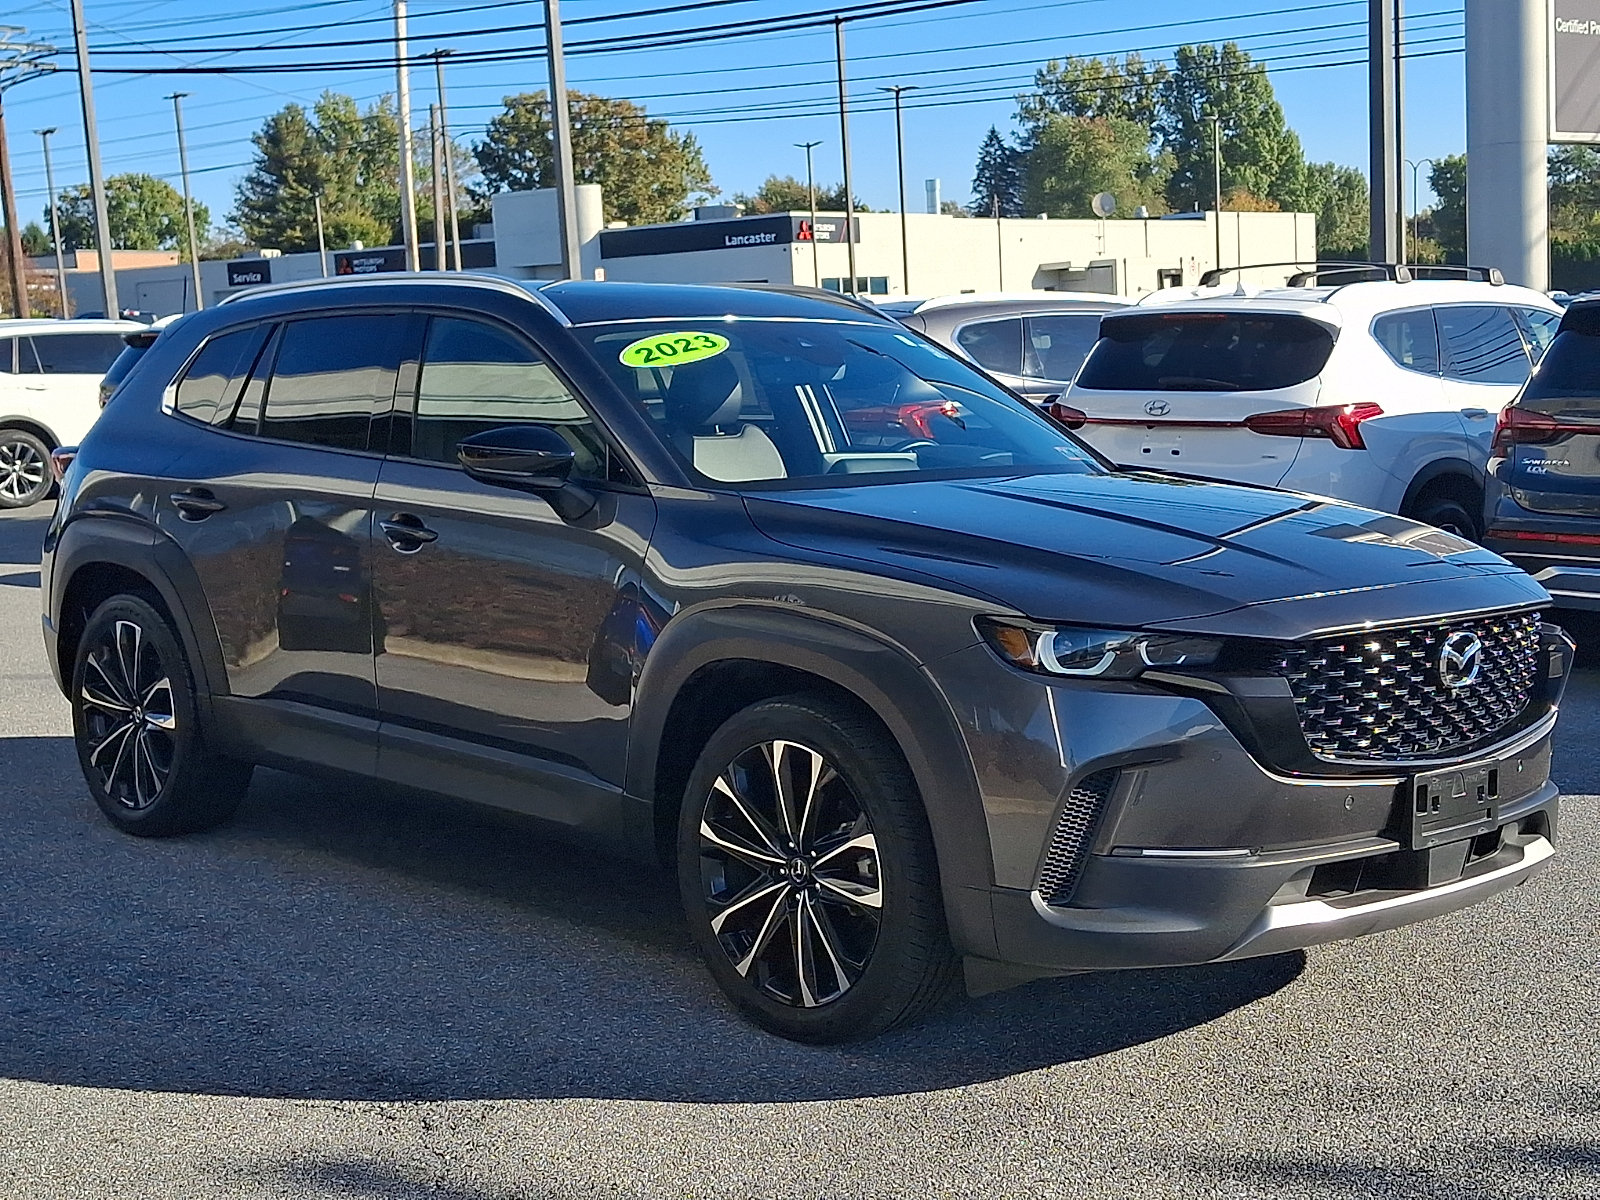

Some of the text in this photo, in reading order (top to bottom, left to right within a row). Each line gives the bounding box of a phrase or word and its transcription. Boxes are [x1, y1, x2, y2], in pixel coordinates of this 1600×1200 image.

[1555, 17, 1600, 35] Certified Pr
[725, 232, 776, 246] Lancaster
[232, 272, 262, 284] Service
[634, 335, 718, 364] 2023
